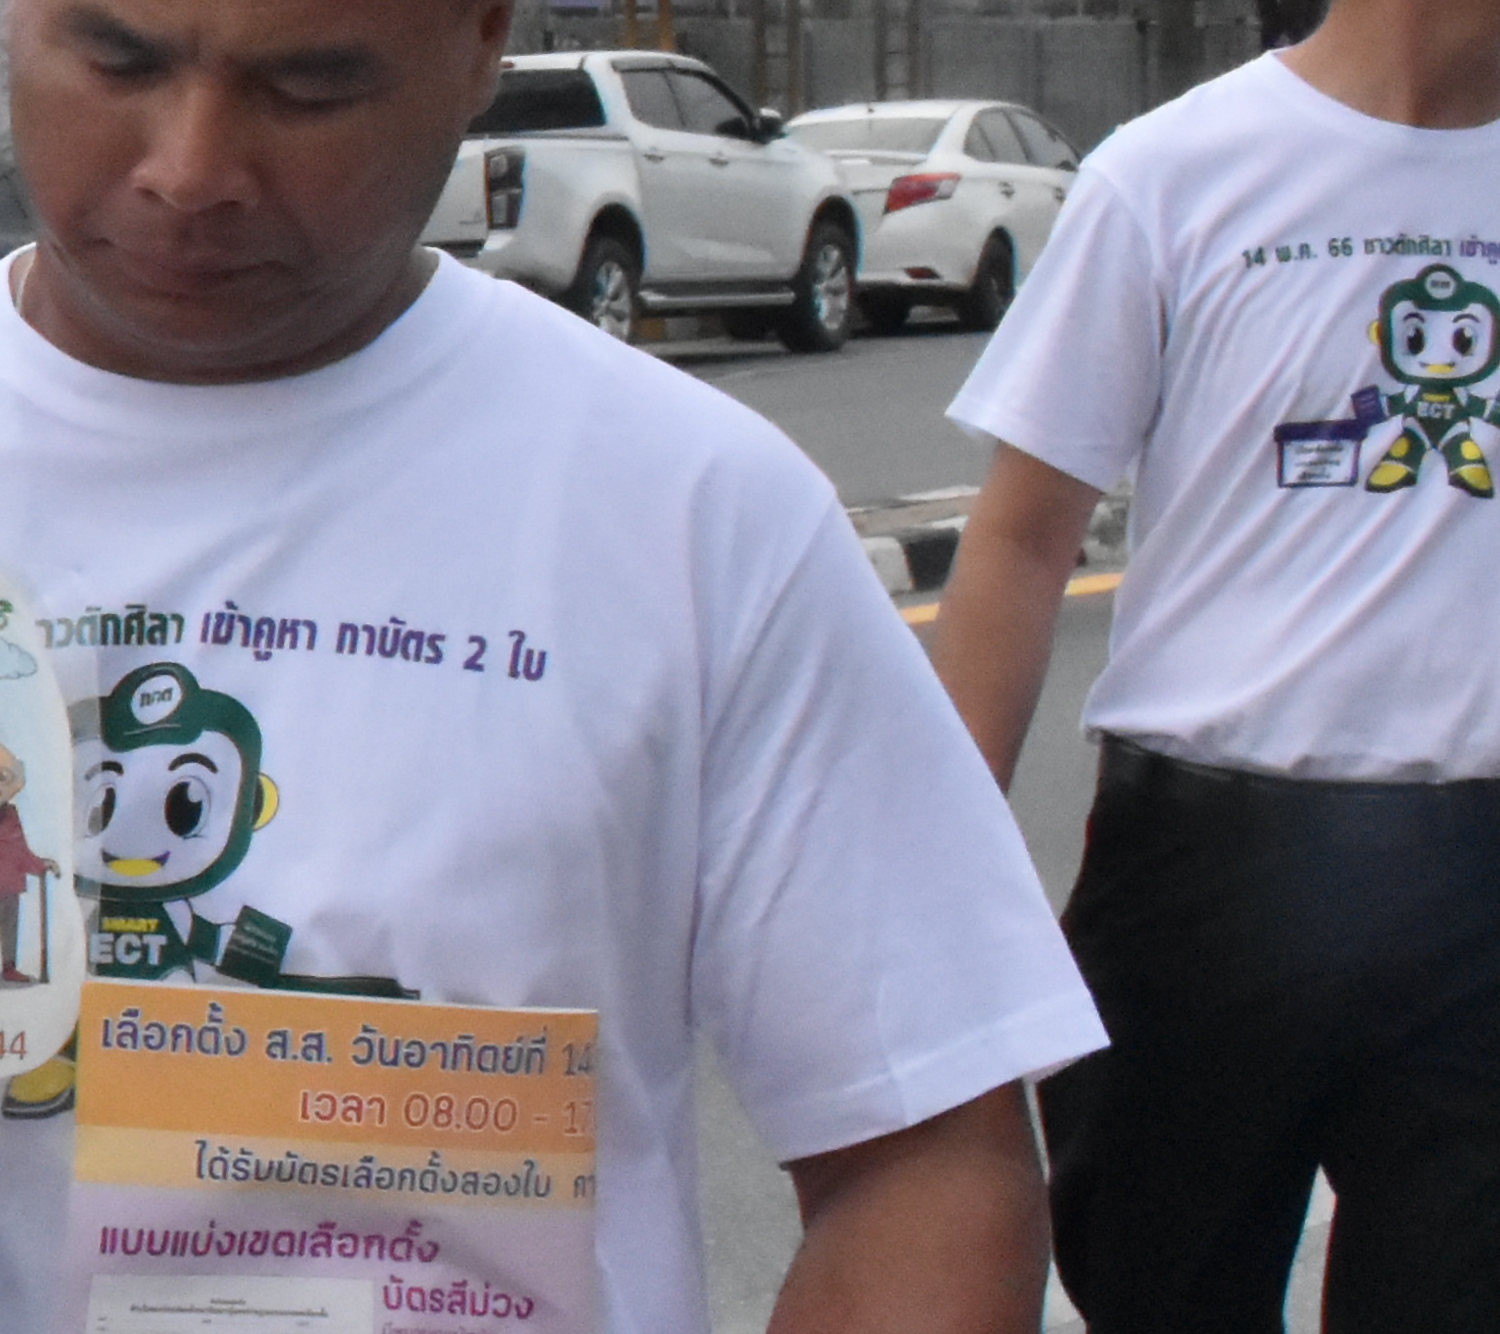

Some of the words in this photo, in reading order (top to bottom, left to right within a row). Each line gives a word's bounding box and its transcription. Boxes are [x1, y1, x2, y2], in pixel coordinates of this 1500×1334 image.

[1328, 237, 1354, 257] 66
[34, 604, 186, 649] าวตักศิลา
[200, 600, 318, 662] เข้าคูหา
[335, 615, 447, 665] กาบัตร
[462, 634, 488, 672] 2
[507, 629, 548, 682] ใบ
[88, 932, 169, 966] ECT
[100, 1001, 249, 1057] เลือกตั้ง
[265, 1028, 333, 1064] ส.ส.
[351, 1023, 548, 1076] วันอาทิตย์ที่
[300, 1090, 387, 1126] เวลา
[404, 1093, 519, 1132] 08.00
[194, 1138, 552, 1199] ได้รับบัตรเลือกตั้งสองใบ
[99, 1219, 441, 1264] แบบแบ่งเขตเลือกตั้ง
[381, 1273, 535, 1320] บัตรสีม่วง
